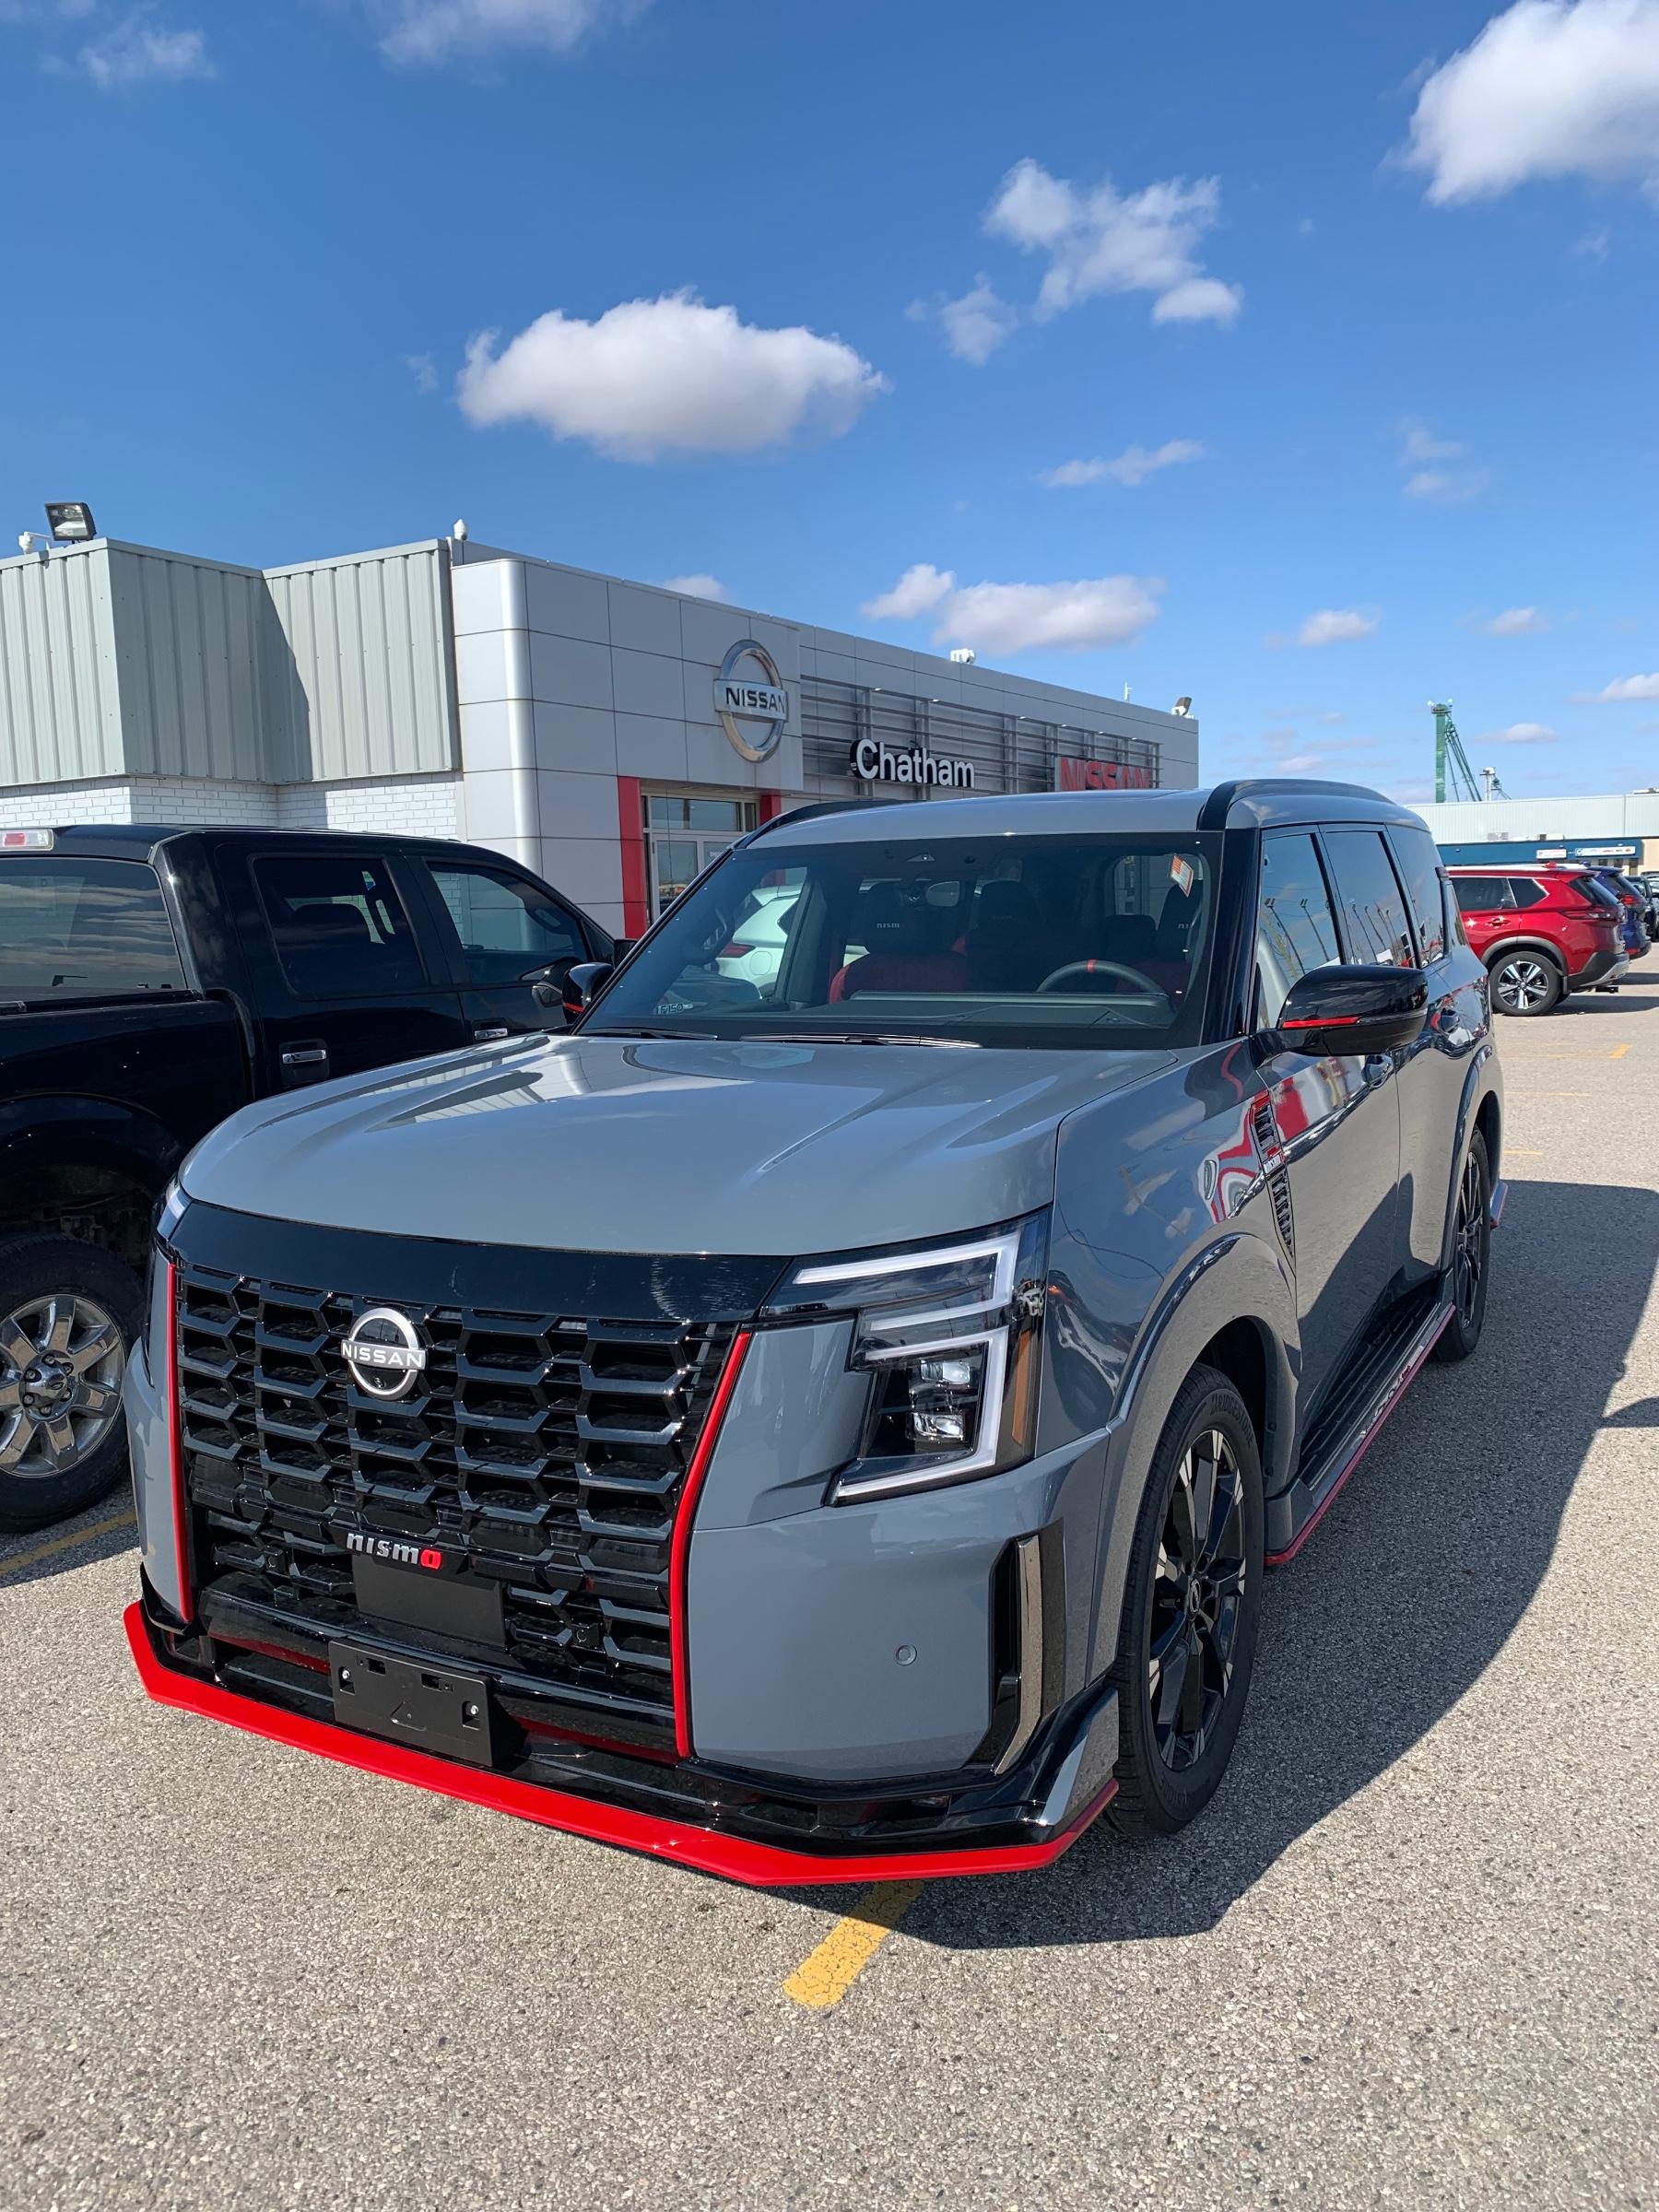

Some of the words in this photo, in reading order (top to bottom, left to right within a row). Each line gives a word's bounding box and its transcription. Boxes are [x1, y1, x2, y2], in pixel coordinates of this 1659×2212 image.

[725, 687, 785, 714] NISSAN
[854, 738, 975, 788] Chatham
[1060, 755, 1151, 791] NISSAN
[342, 1342, 424, 1368] NISSAN
[346, 1533, 442, 1570] nismo
